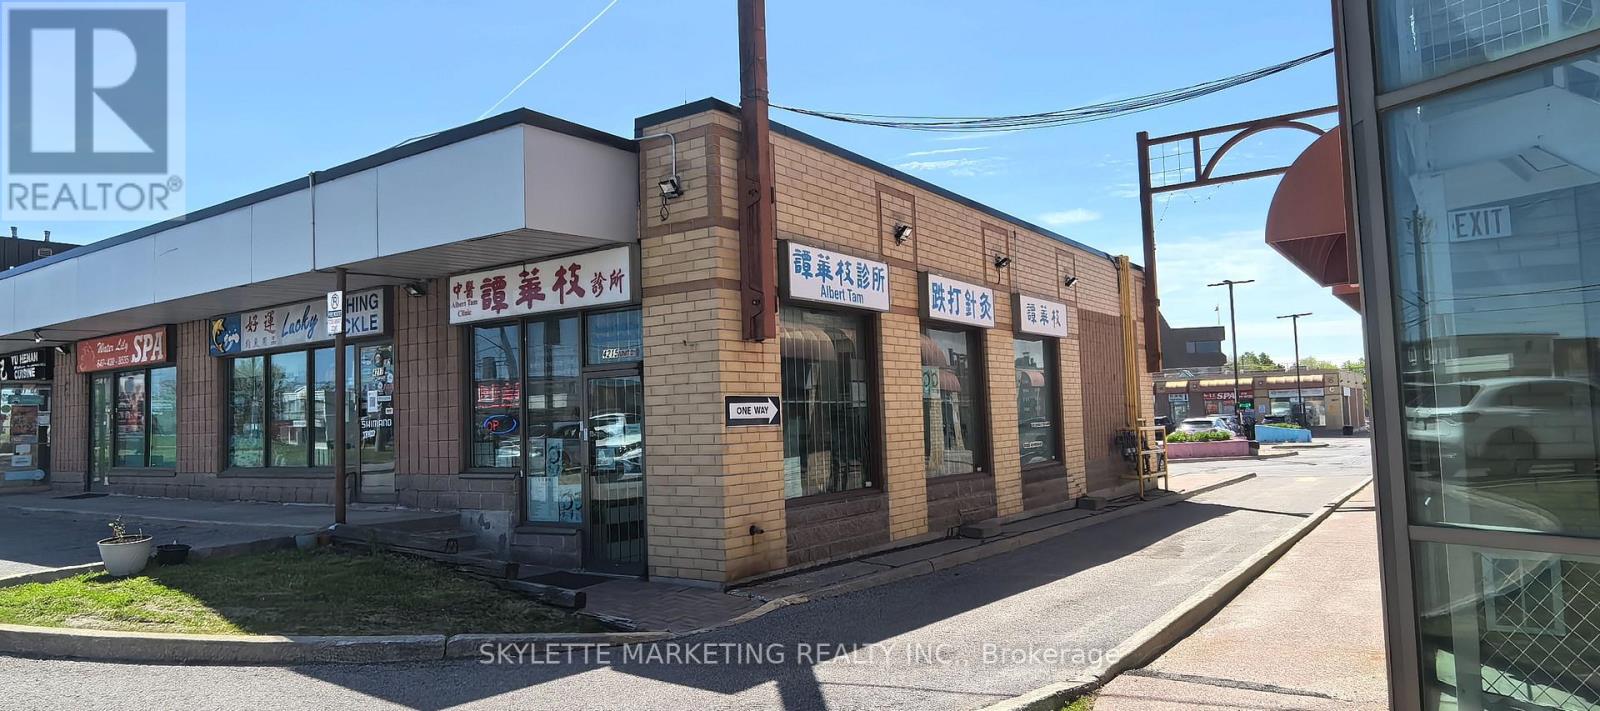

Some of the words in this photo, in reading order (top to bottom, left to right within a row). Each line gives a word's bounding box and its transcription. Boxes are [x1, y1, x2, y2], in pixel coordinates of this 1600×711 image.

[1454, 208, 1502, 239] EXIT
[346, 293, 379, 314] HING
[820, 284, 845, 302] Albert
[847, 288, 864, 304] Tam
[931, 281, 992, 320] 跌打針灸
[452, 301, 466, 309] Albert
[346, 314, 379, 334] CKLE
[131, 332, 163, 363] SPA
[14, 367, 35, 380] CUISINE
[1216, 392, 1235, 400] SPA
[736, 406, 751, 415] ONE
[754, 405, 769, 415] WAY
[361, 419, 392, 429] SHIMANO
